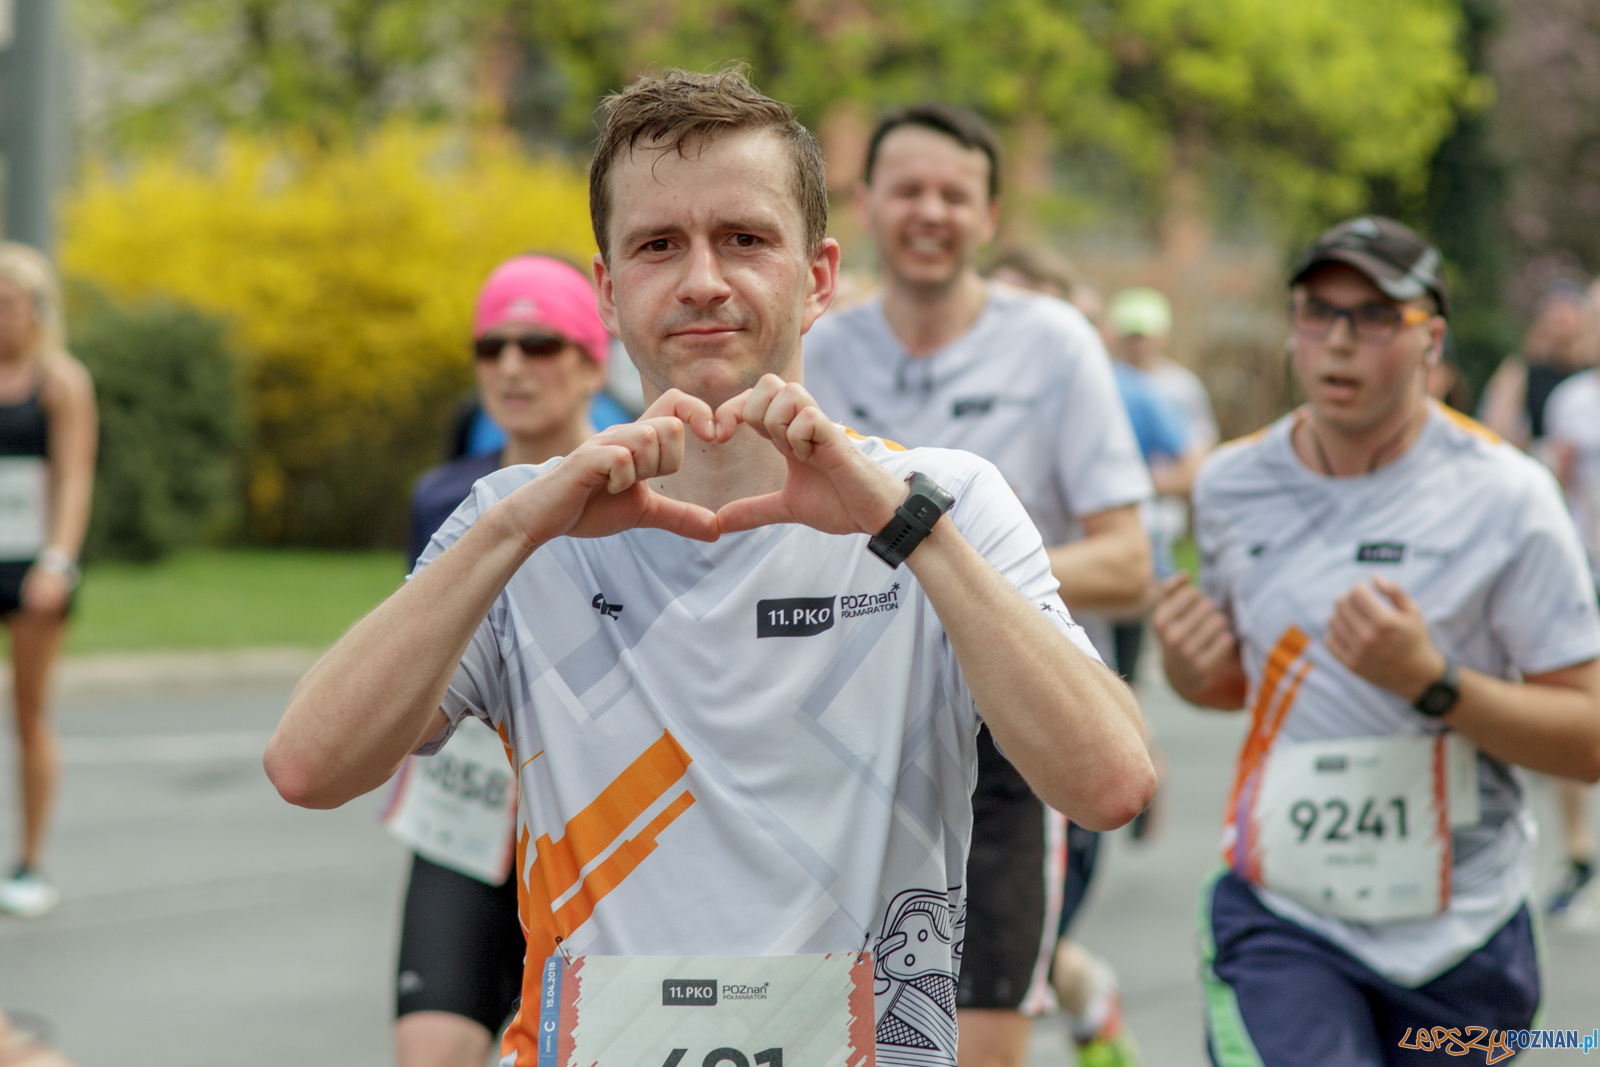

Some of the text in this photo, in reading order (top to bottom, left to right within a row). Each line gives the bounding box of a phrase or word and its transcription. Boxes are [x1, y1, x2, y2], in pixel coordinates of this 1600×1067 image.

[767, 608, 790, 626] 11.
[793, 607, 831, 626] PKO
[1289, 796, 1409, 843] 9241
[546, 961, 557, 1009] 15.04.2018
[668, 986, 684, 999] 11.
[685, 986, 714, 999] PKO
[543, 1020, 557, 1033] C
